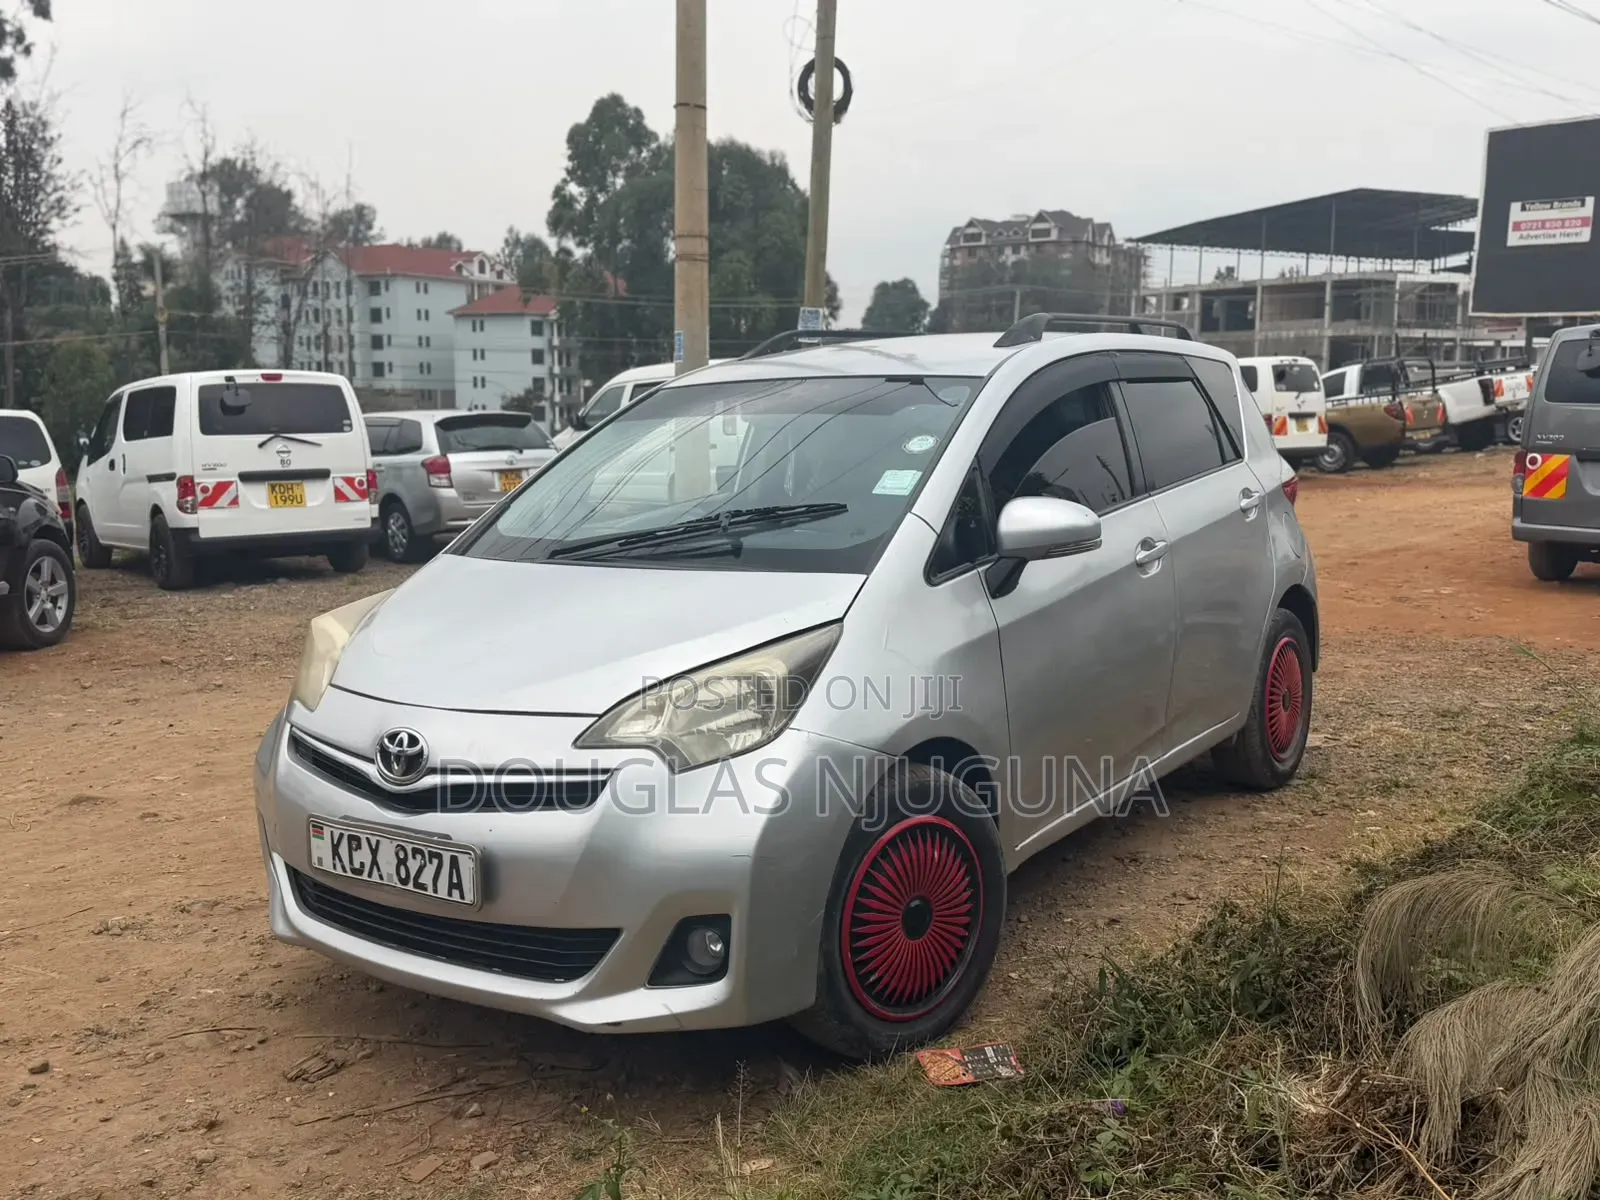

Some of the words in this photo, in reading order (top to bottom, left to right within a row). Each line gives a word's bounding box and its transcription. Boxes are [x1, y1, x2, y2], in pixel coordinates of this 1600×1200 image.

[1525, 203, 1551, 211] Yellow
[1553, 200, 1581, 209] Brands
[1519, 231, 1556, 239] Advertise
[1560, 230, 1583, 238] Here!
[270, 483, 294, 494] KDH
[274, 495, 303, 505] 199U
[330, 830, 384, 881] KCX
[394, 843, 465, 900] 827A
